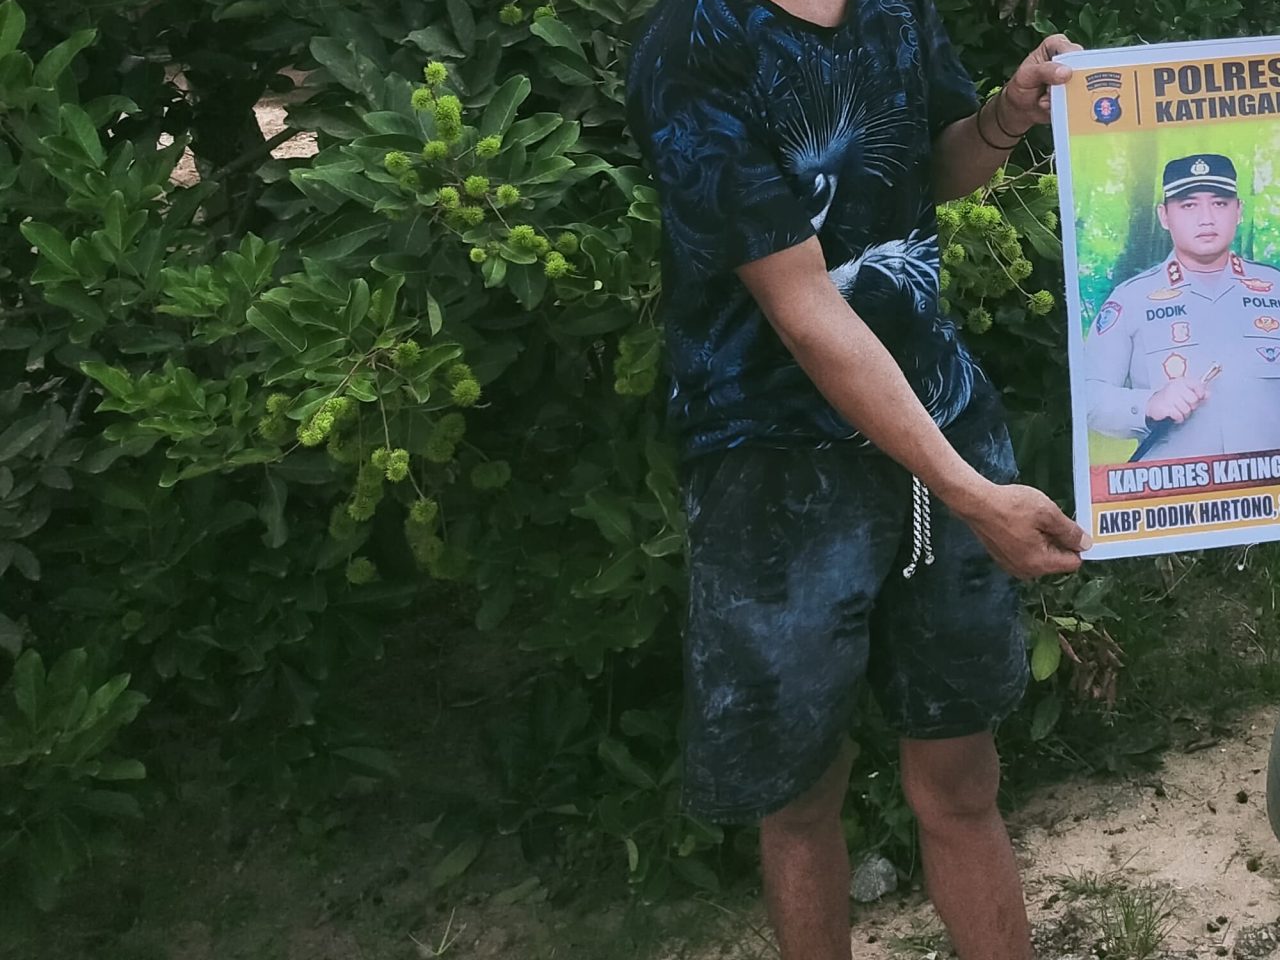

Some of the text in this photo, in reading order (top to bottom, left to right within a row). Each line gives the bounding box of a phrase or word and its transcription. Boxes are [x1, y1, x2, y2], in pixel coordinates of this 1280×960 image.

[1146, 304, 1188, 322] DODIK
[1108, 462, 1209, 495] KAPOLRES
[1099, 511, 1141, 534] AKBP
[1146, 505, 1196, 530] DODIK
[1200, 498, 1277, 524] HARTONO,
